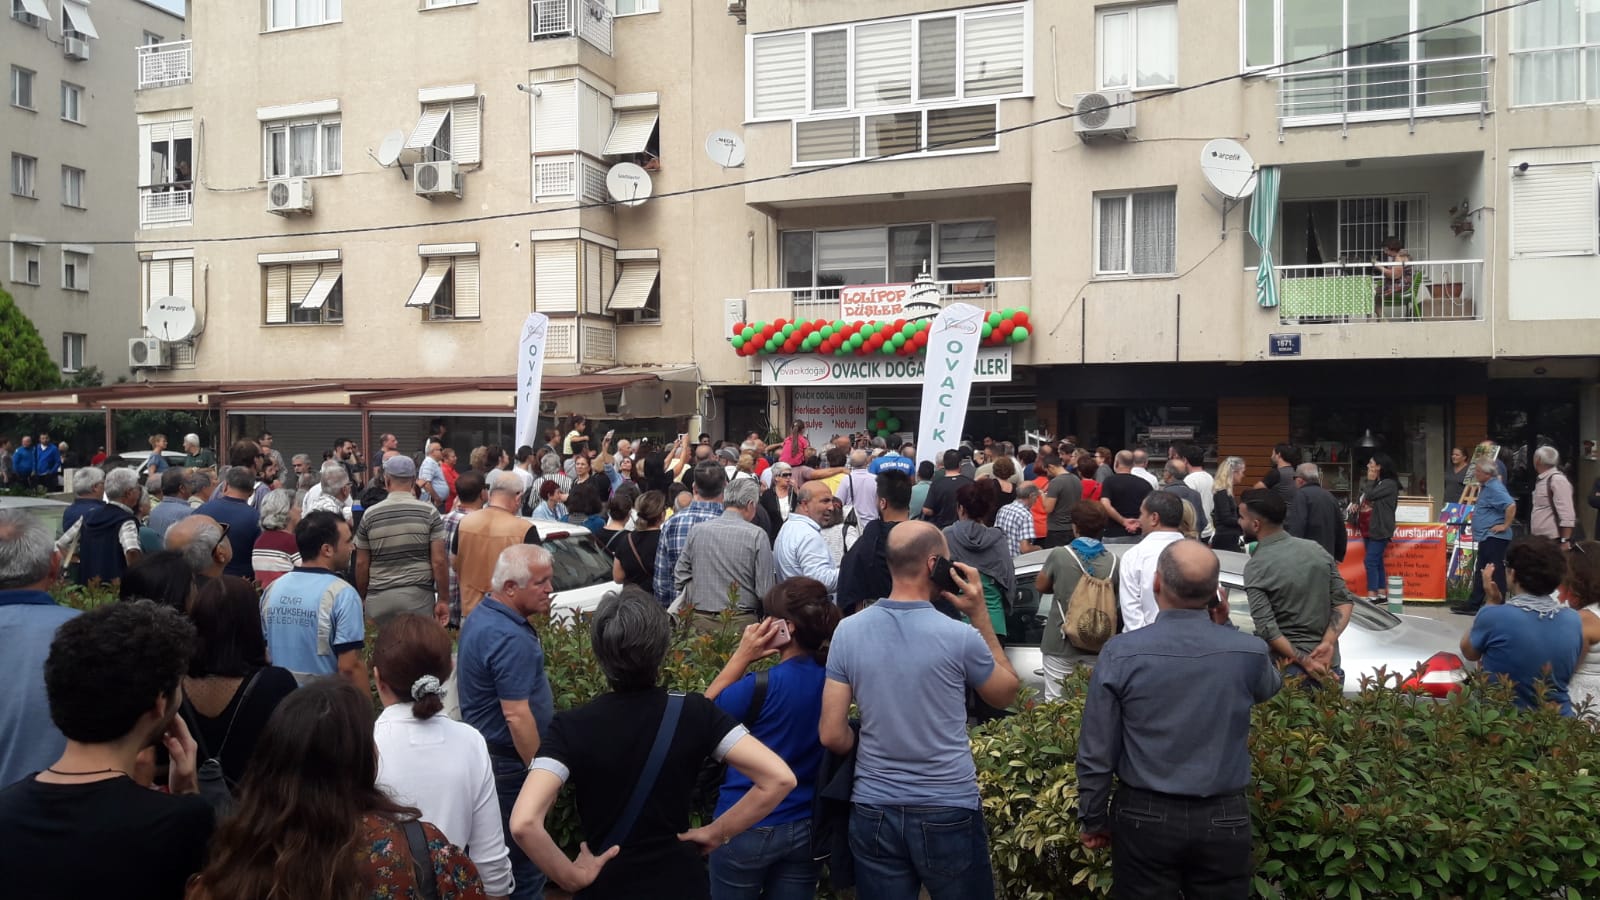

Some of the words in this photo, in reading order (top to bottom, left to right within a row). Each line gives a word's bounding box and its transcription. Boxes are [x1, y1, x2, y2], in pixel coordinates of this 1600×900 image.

[843, 288, 906, 304] LOLİPOP
[845, 304, 903, 317] DÜŞLER
[832, 361, 880, 379] OVACIK
[885, 356, 925, 378] DOĞA
[932, 340, 963, 443] OVACIK
[794, 406, 820, 415] Herkese
[848, 405, 865, 415] Gıda
